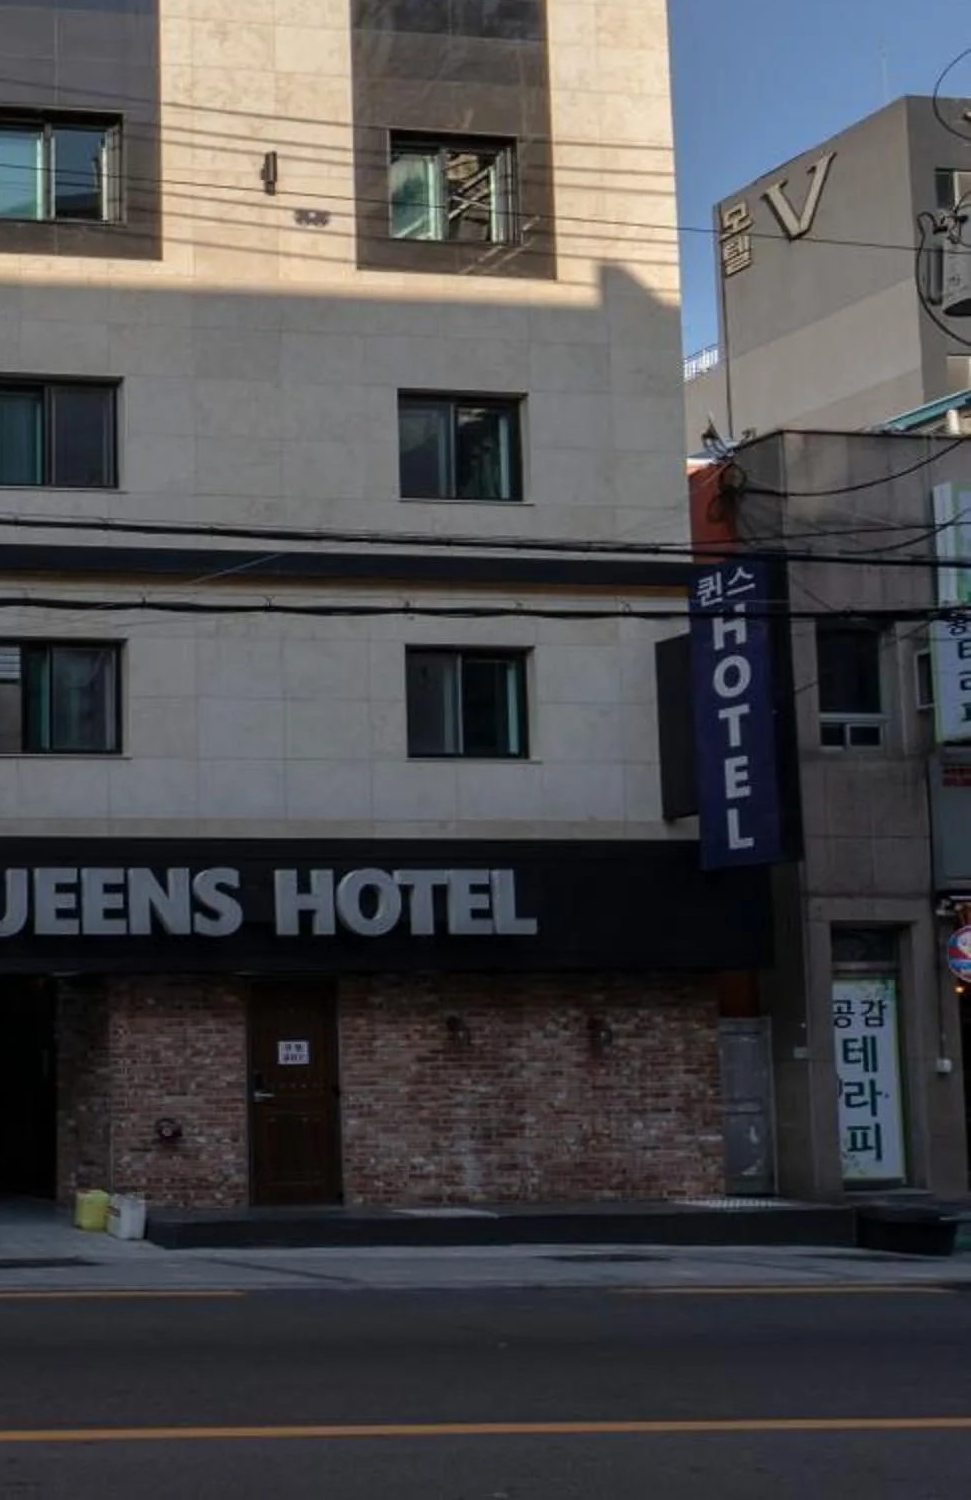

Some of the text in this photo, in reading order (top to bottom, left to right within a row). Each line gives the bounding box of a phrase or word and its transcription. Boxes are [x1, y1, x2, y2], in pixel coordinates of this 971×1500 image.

[761, 151, 837, 241] V
[720, 202, 754, 276] 모텔
[697, 566, 756, 607] 퀸스
[713, 604, 754, 851] HOTEL
[274, 868, 538, 937] HOTEL
[833, 1000, 888, 1029] 공감
[842, 1035, 884, 1162] 테라피
